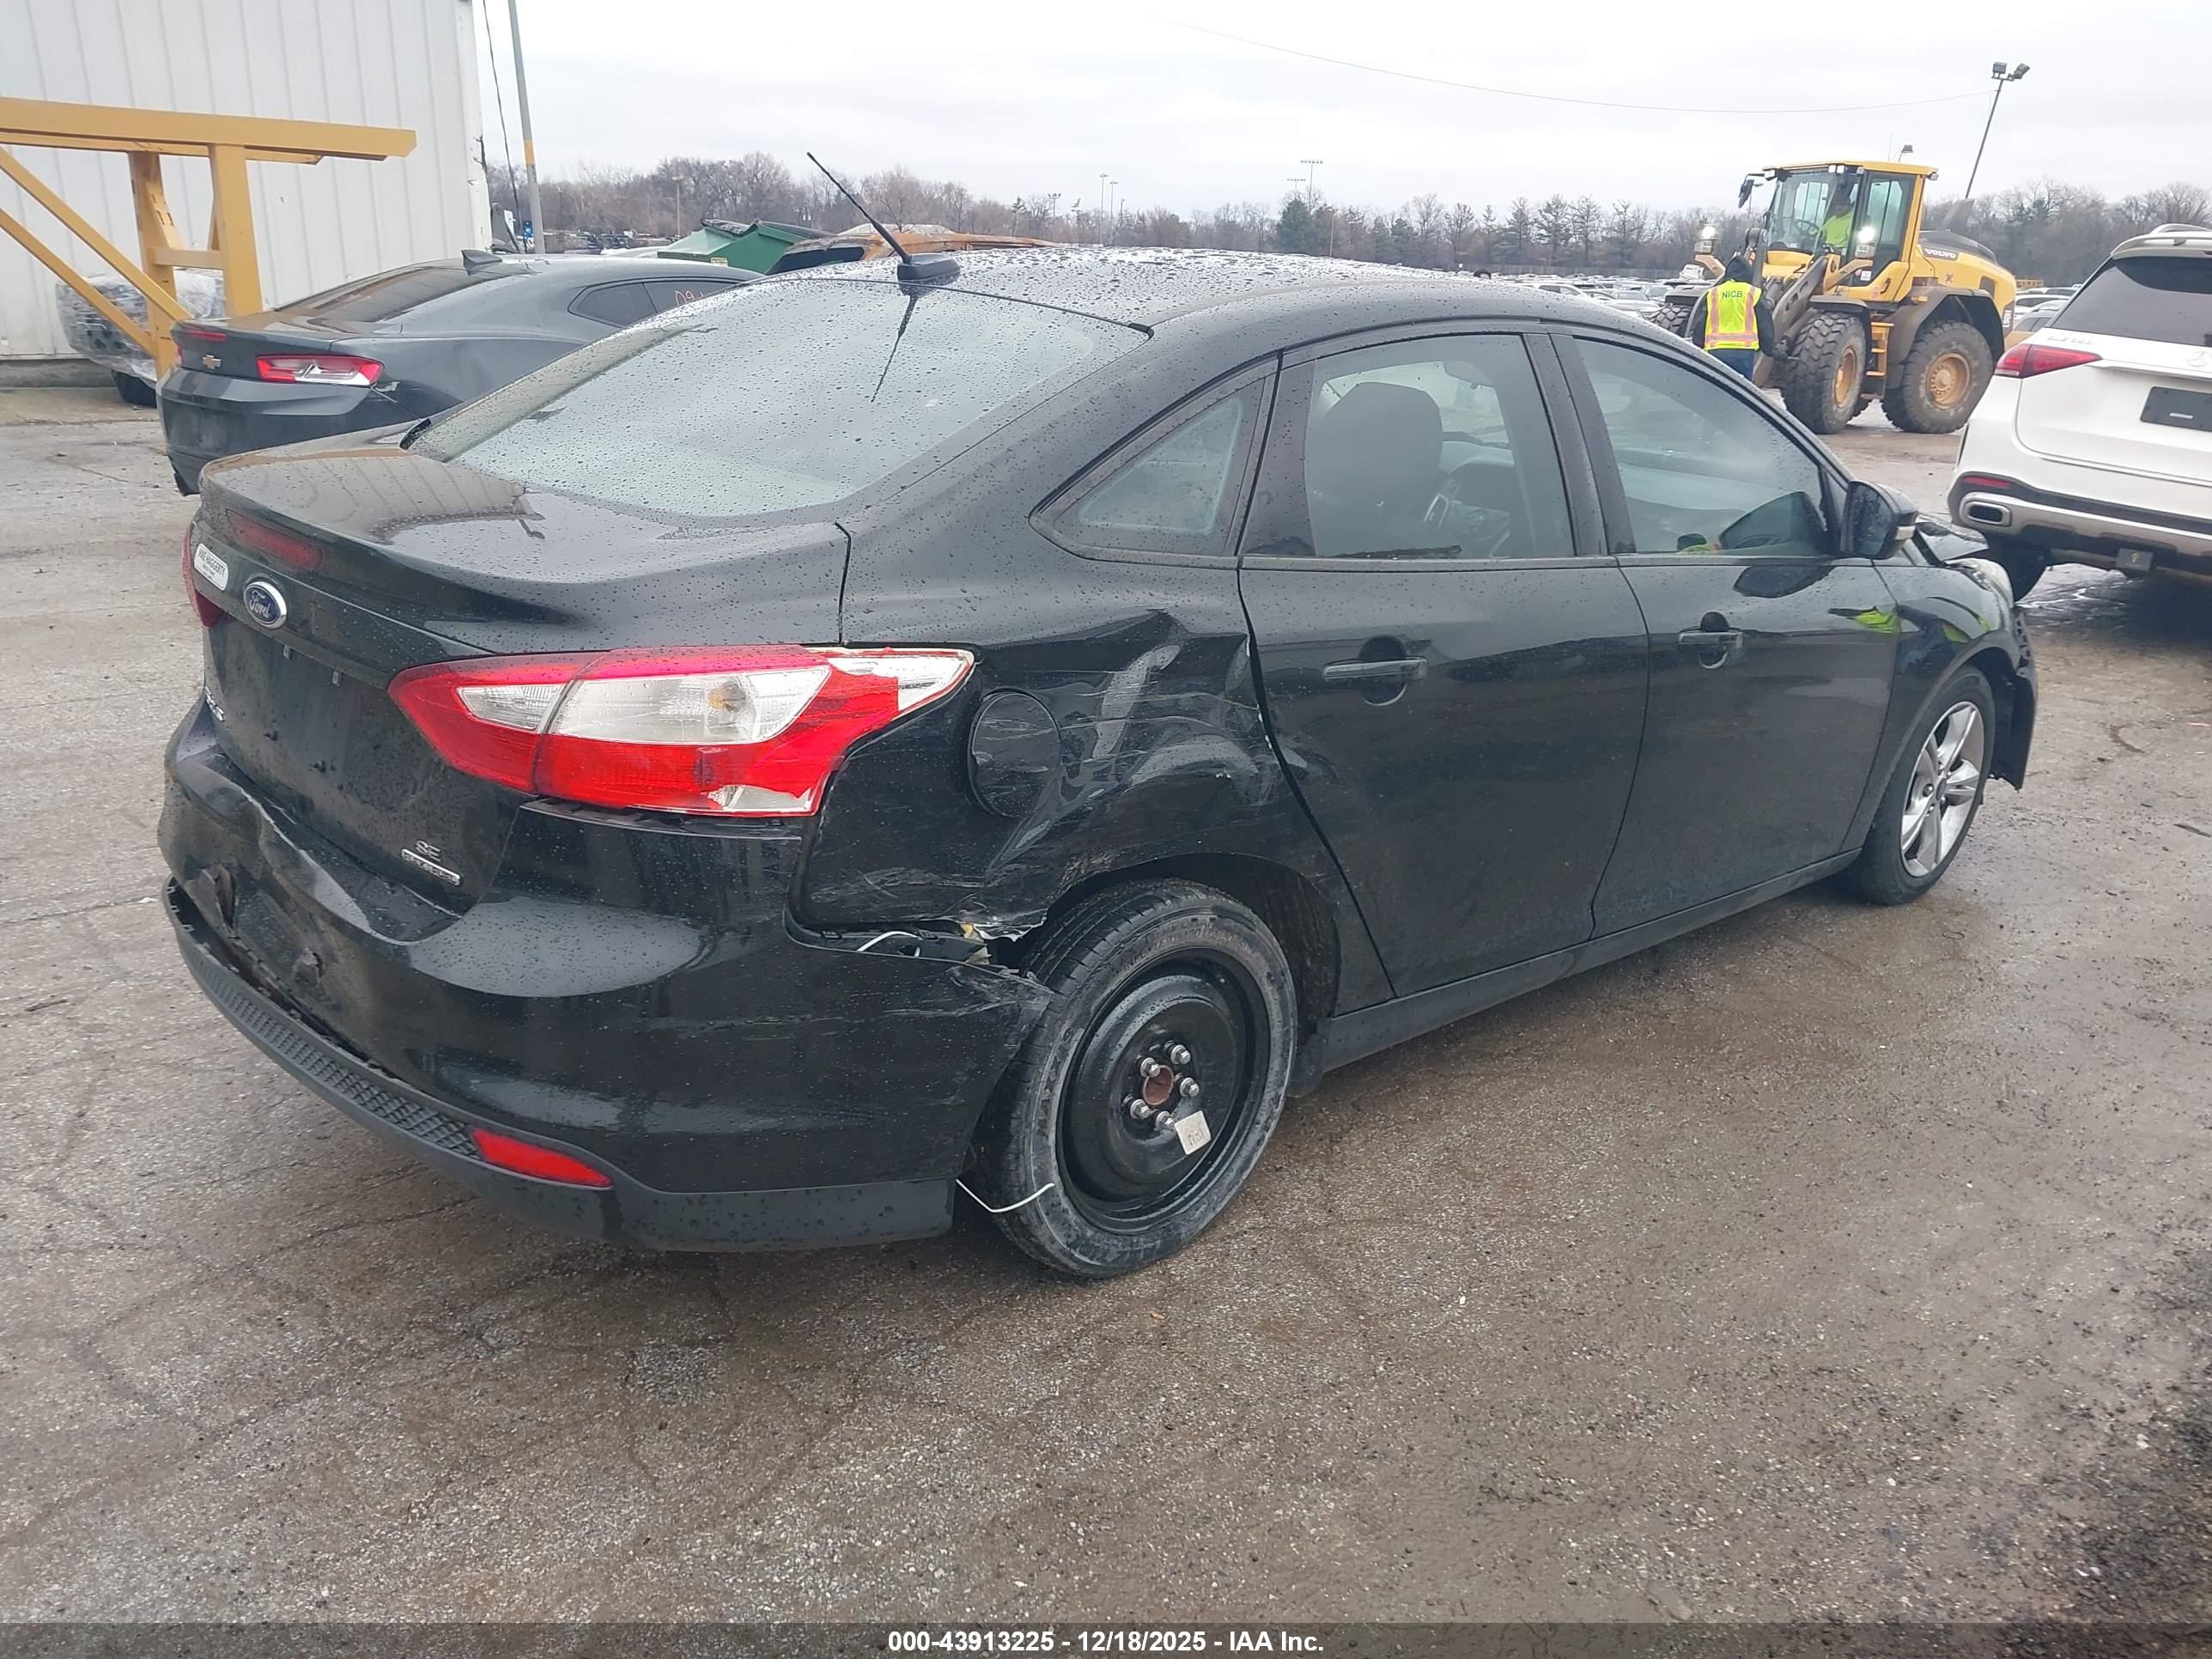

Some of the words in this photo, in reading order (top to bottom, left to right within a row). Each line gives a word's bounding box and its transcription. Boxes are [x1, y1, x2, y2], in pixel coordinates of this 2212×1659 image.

[1923, 248, 1956, 258] VOLVO
[1722, 290, 1743, 300] NICB
[249, 589, 271, 619] Ford
[415, 840, 441, 862] SE
